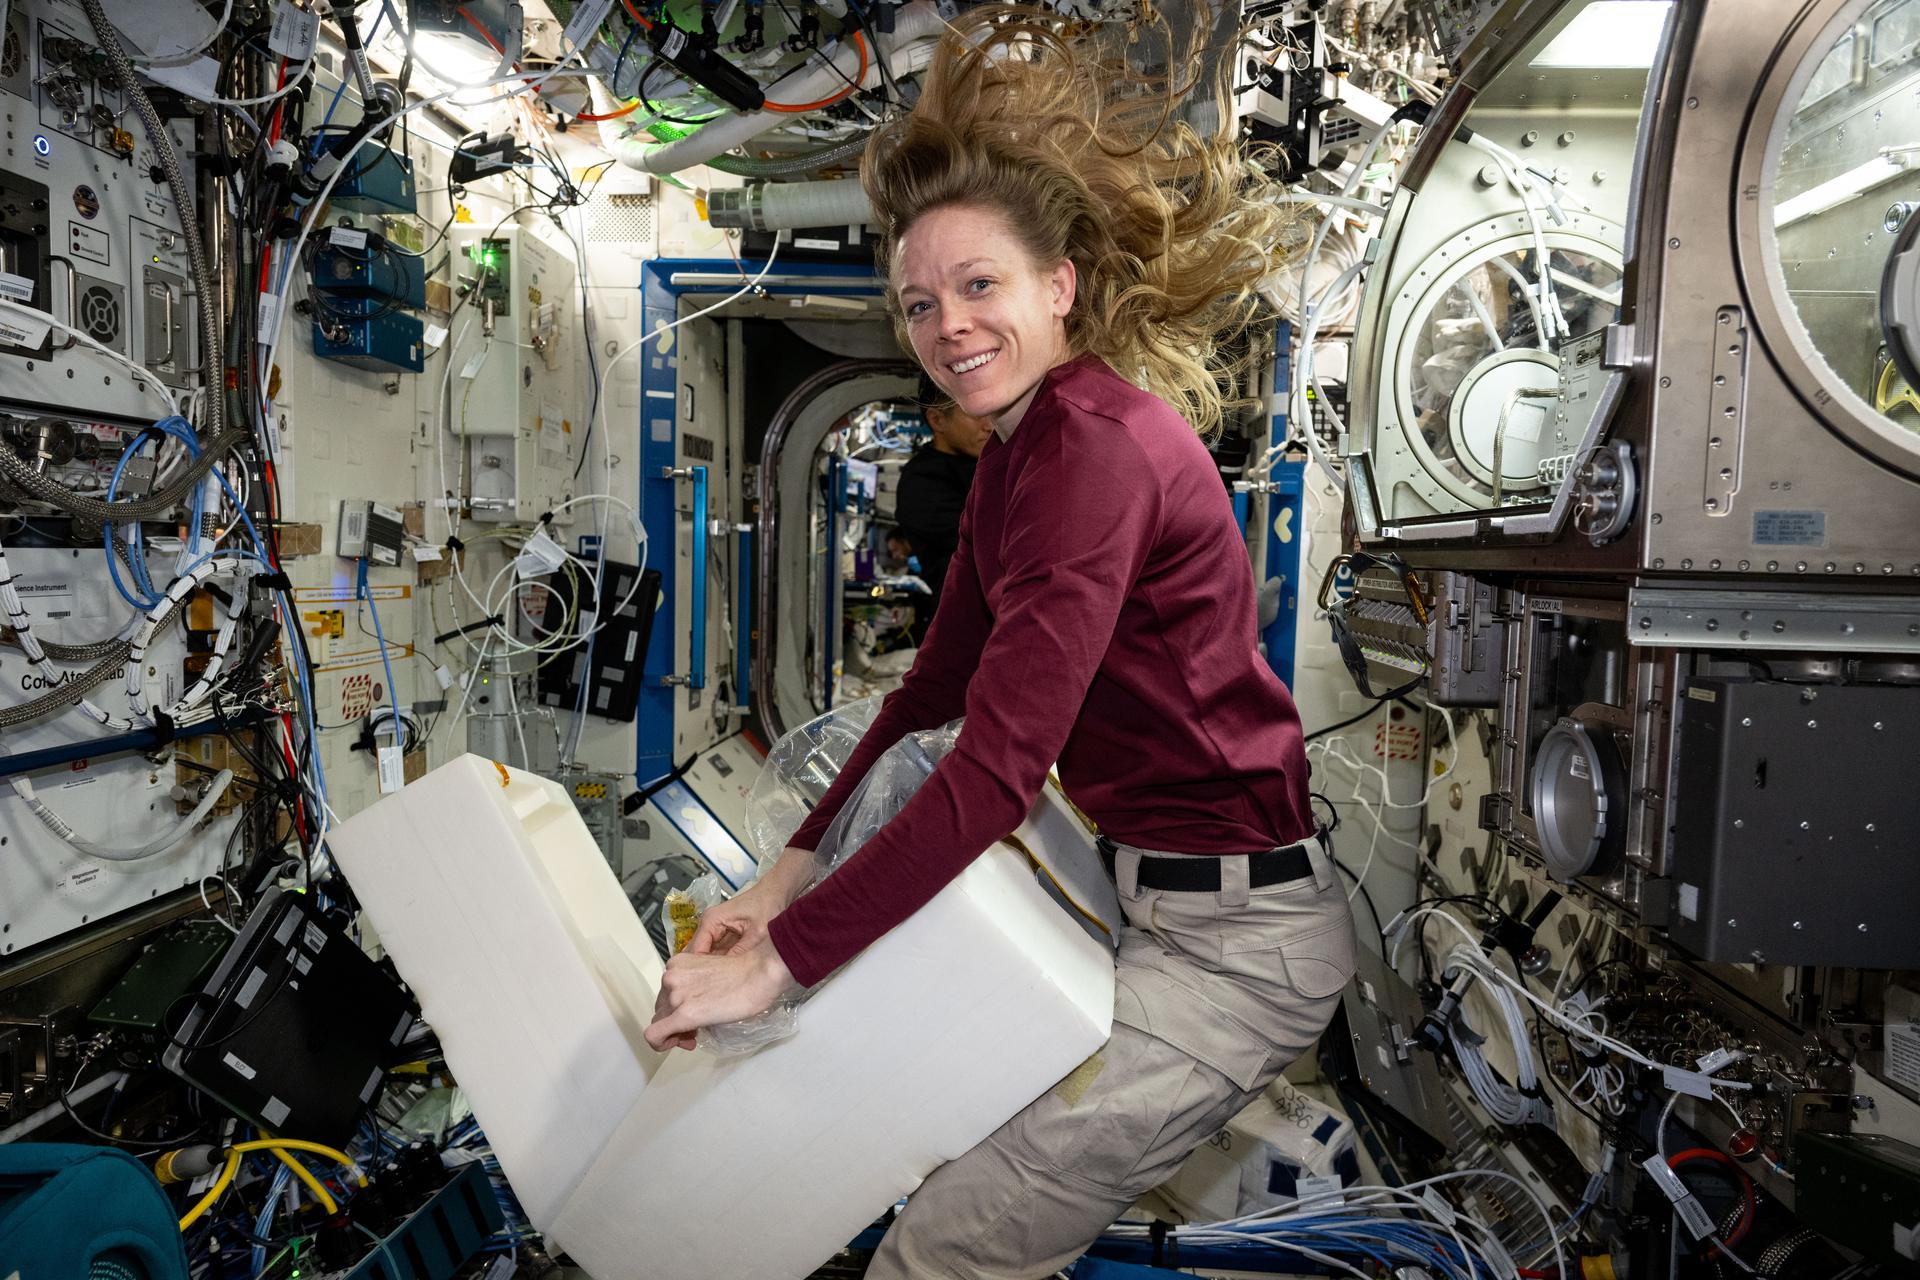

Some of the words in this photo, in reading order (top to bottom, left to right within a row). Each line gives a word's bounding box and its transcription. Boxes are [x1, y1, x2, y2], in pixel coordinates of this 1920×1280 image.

[15, 584, 34, 592] cience
[35, 583, 67, 592] Instrument
[103, 667, 125, 681] ab
[72, 869, 99, 879] Magnetometer
[76, 876, 93, 885] Location
